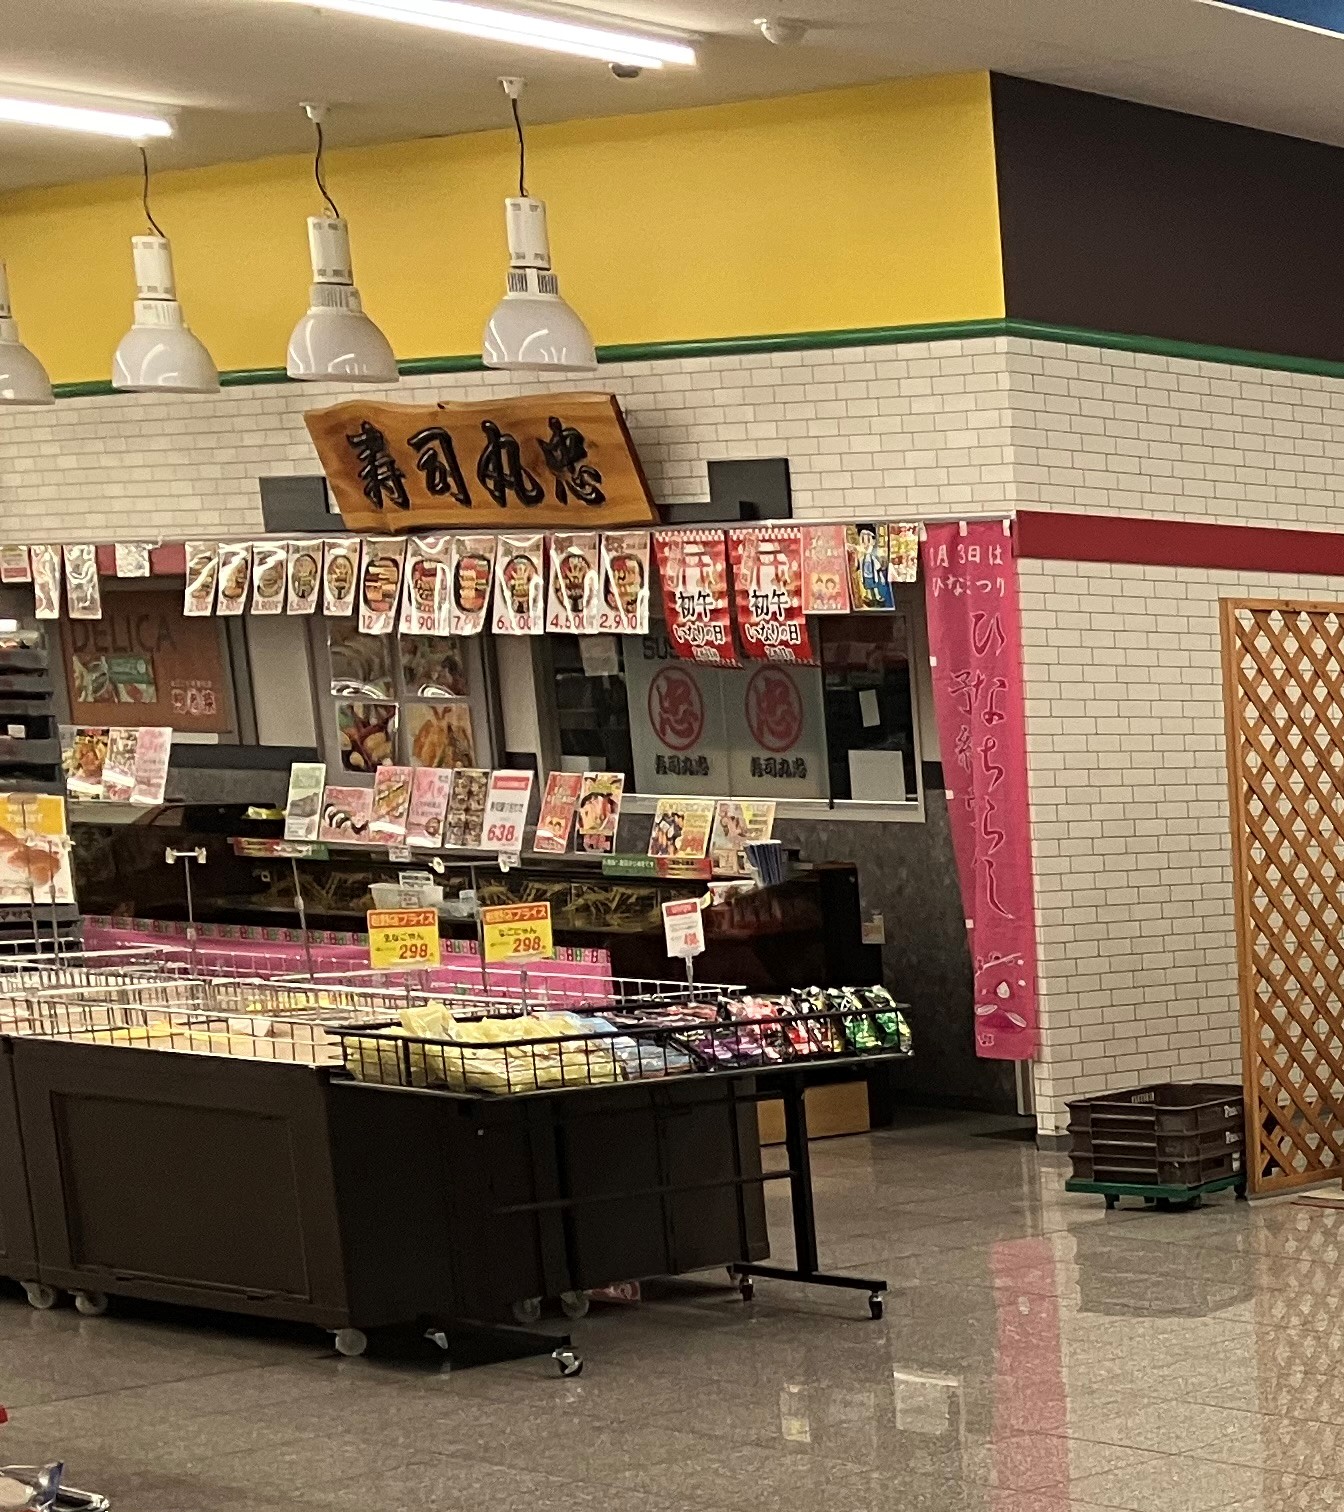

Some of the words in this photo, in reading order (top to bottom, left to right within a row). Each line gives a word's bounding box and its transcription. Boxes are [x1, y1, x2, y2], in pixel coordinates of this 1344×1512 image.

[347, 416, 606, 510] 寿司丸忠
[678, 590, 713, 619] 初午
[751, 589, 789, 619] 初午
[70, 614, 177, 654] DELICA
[674, 624, 724, 643] いなりの日
[746, 623, 800, 644] いなりの日
[970, 609, 1015, 920] ひなちらし
[399, 943, 428, 959] 298
[512, 936, 541, 953] 298
